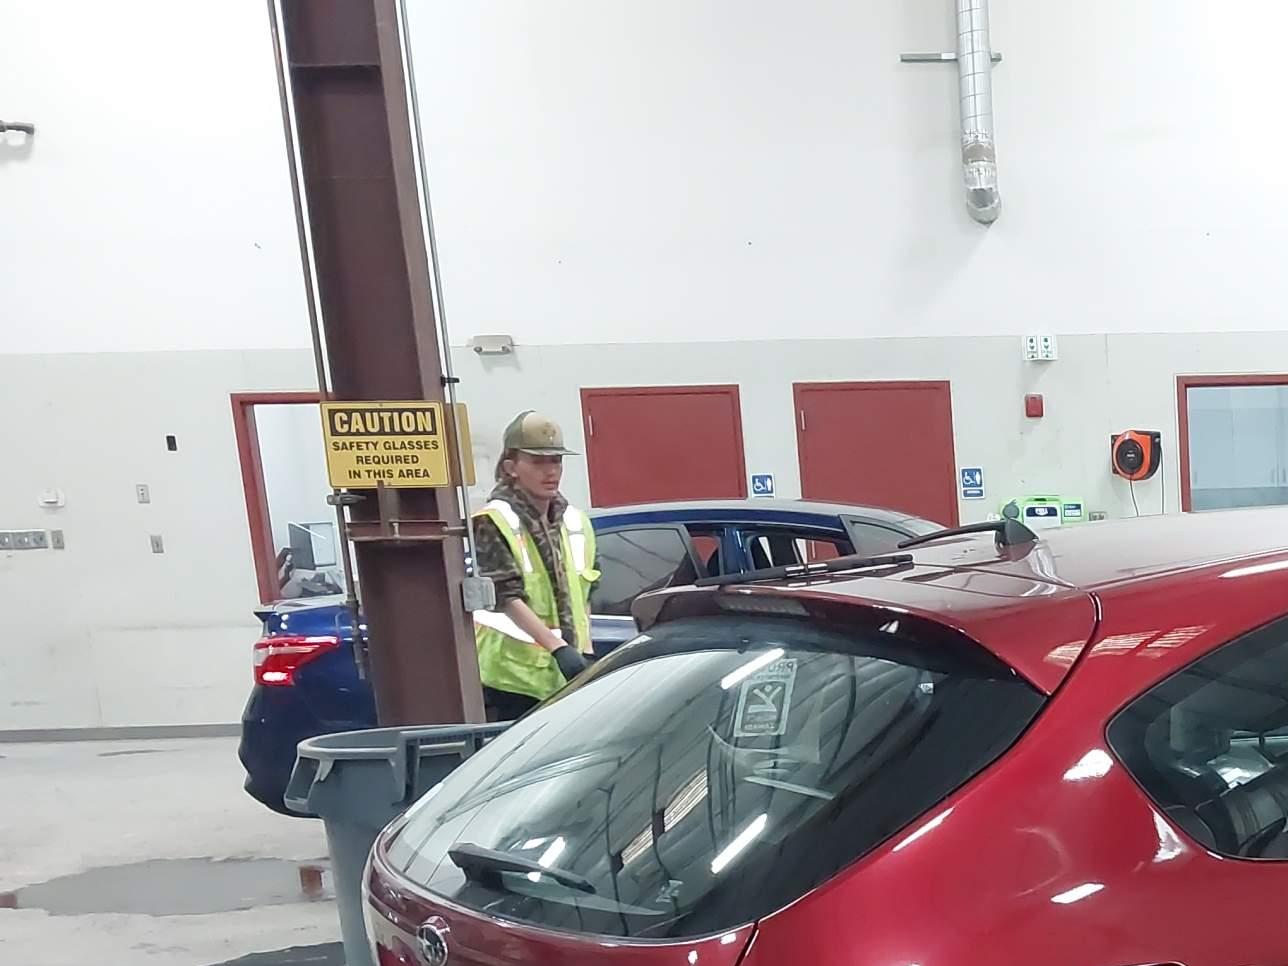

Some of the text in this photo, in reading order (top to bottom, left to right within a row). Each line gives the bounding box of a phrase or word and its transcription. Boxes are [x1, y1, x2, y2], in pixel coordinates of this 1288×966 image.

[333, 411, 433, 433] CAUTION
[332, 440, 439, 452] SAFETY GLASSES
[355, 454, 420, 465] REQUIRED
[348, 468, 431, 480] IN THIS AREA
